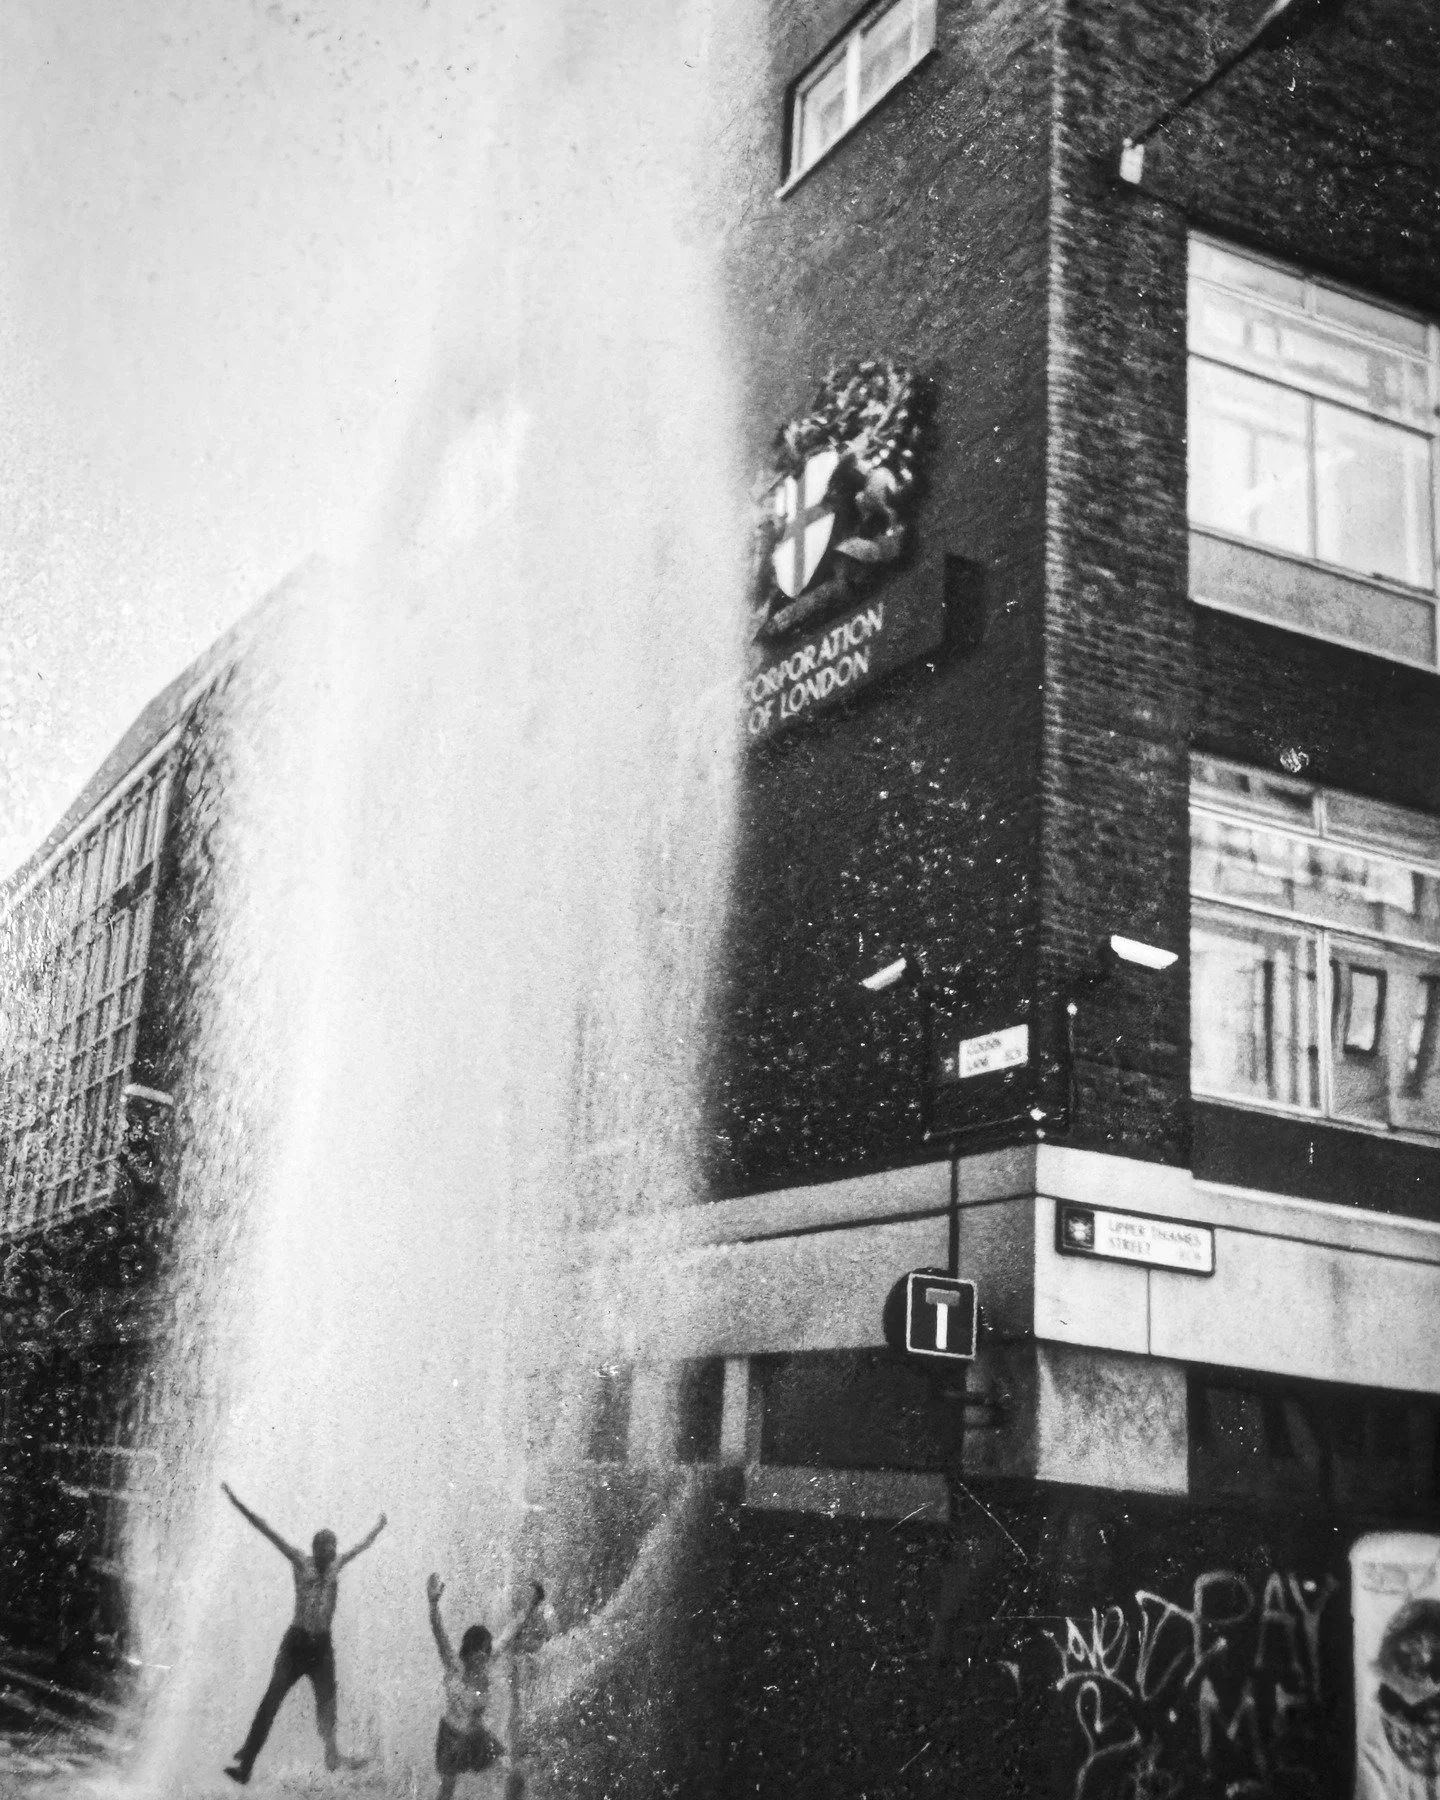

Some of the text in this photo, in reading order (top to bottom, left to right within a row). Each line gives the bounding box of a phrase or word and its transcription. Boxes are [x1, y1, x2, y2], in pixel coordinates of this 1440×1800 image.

[749, 646, 870, 734] OF LONDON
[1108, 1219, 1203, 1247] UPPER THAMES
[1109, 1236, 1151, 1255] STREET
